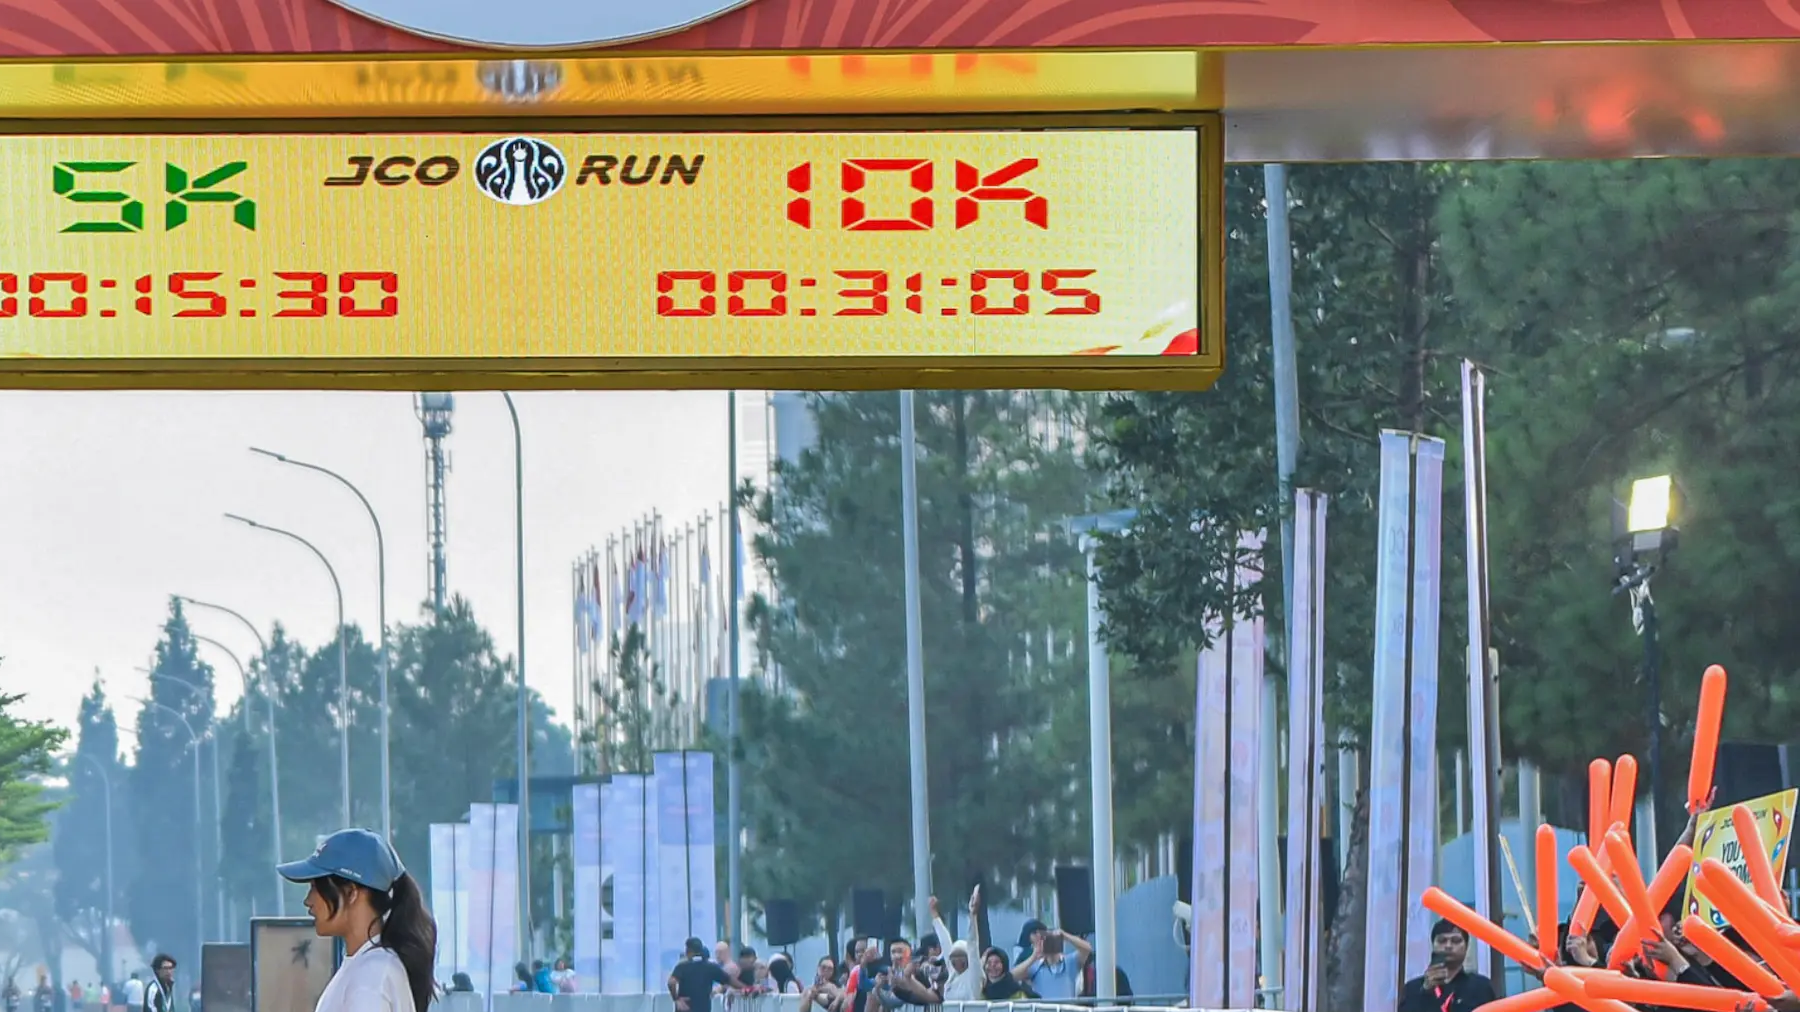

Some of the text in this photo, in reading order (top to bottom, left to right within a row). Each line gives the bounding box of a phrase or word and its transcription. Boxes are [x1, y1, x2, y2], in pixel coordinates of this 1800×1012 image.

[53, 161, 256, 233] 5K
[324, 154, 705, 186] JCO RUN
[787, 158, 1048, 231] 10K
[657, 269, 1100, 316] 00:31:05
